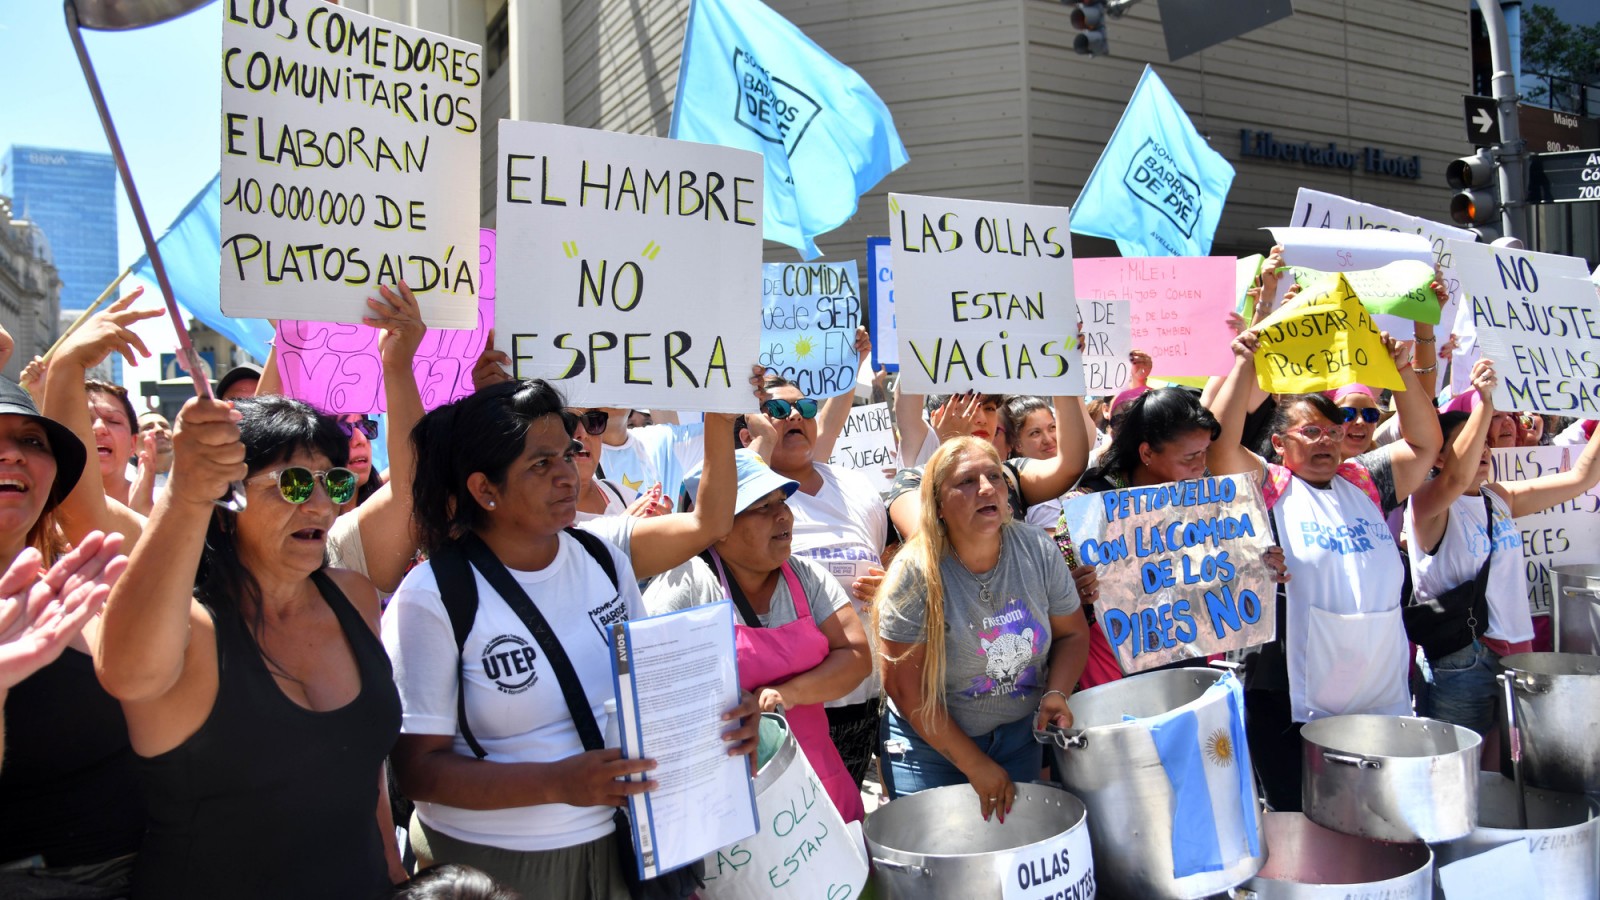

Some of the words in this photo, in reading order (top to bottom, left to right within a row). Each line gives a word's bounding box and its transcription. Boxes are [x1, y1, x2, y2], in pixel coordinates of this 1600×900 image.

[227, 0, 298, 40] LOS
[307, 7, 480, 87] COMEDORES
[745, 92, 771, 125] DE
[1553, 113, 1579, 128] Maipú
[29, 152, 68, 165] BBVA
[227, 112, 430, 173] ELABORAN
[1239, 128, 1361, 171] Libertador
[1363, 147, 1423, 179] Hotel
[1546, 141, 1560, 152] 800
[507, 153, 567, 207] EL
[580, 160, 756, 227] HAMBRE
[1133, 165, 1165, 195] DE
[1163, 193, 1192, 224] PIE
[374, 194, 427, 231] DE
[975, 216, 1065, 259] OLLAS
[222, 233, 371, 284] PLATOS
[1495, 253, 1539, 293] NO
[764, 278, 782, 296] DE
[1165, 288, 1202, 301] COMEN
[816, 296, 860, 331] SER
[951, 291, 1045, 323] ESTAN
[1091, 301, 1115, 325] DE
[1358, 311, 1379, 335] AL
[824, 331, 859, 367] EN
[1083, 331, 1115, 356] AR
[1156, 326, 1192, 338] TAMBIEN
[512, 330, 732, 389] ESPERA
[1083, 361, 1127, 390] BLO
[1512, 345, 1550, 377] EN
[1551, 347, 1600, 380] LAS
[1103, 477, 1236, 523] PETTOVELLO
[1080, 534, 1128, 568] CON
[1135, 526, 1165, 558] LA
[1302, 533, 1375, 555] POPULAR
[1141, 558, 1176, 594] DE
[1182, 551, 1235, 586] LOS
[1103, 599, 1198, 659] PIBES
[1204, 585, 1261, 639] NO
[481, 646, 537, 680] UTEP
[773, 777, 821, 837] OLLA
[768, 821, 828, 889] ESTAN
[1018, 848, 1070, 890] OLLAS
